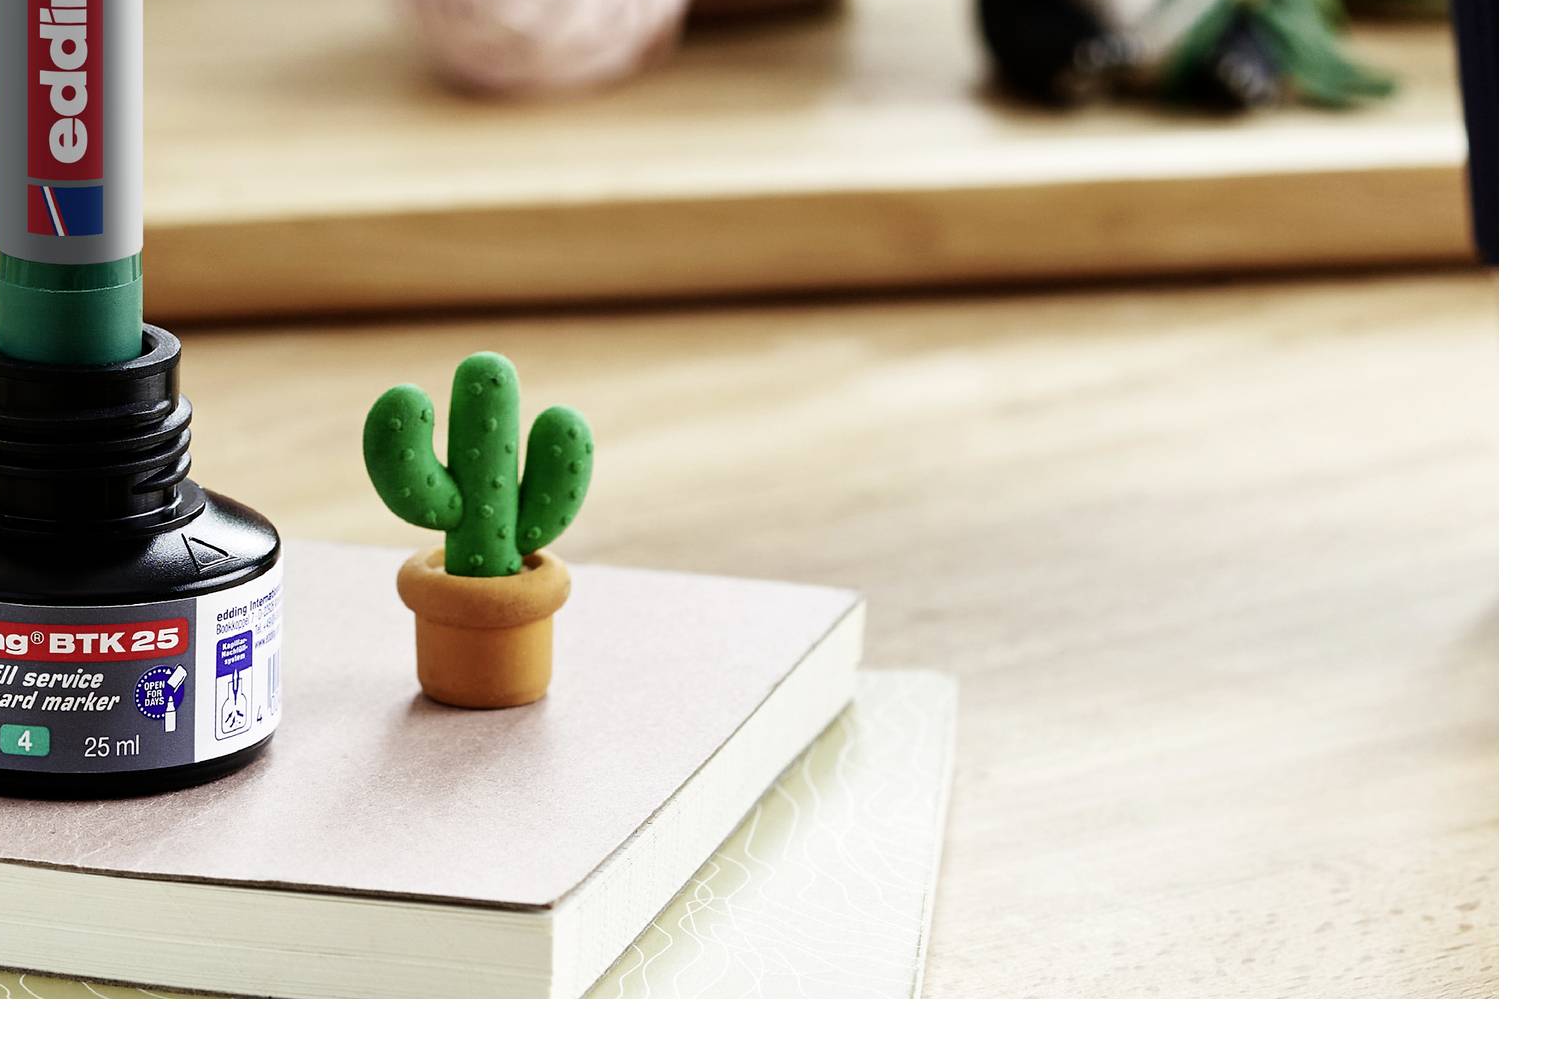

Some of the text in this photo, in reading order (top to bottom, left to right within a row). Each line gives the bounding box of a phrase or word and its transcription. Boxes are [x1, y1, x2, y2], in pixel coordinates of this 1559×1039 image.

[216, 605, 248, 621] edding
[49, 631, 127, 654] BTK
[130, 627, 180, 652] 25
[22, 668, 104, 689] service
[144, 680, 166, 691] OPEN
[41, 692, 121, 711] marker
[144, 696, 165, 707] DAYS
[146, 689, 163, 698] FOR
[17, 729, 33, 752] 4
[84, 734, 140, 757] 25 ml
